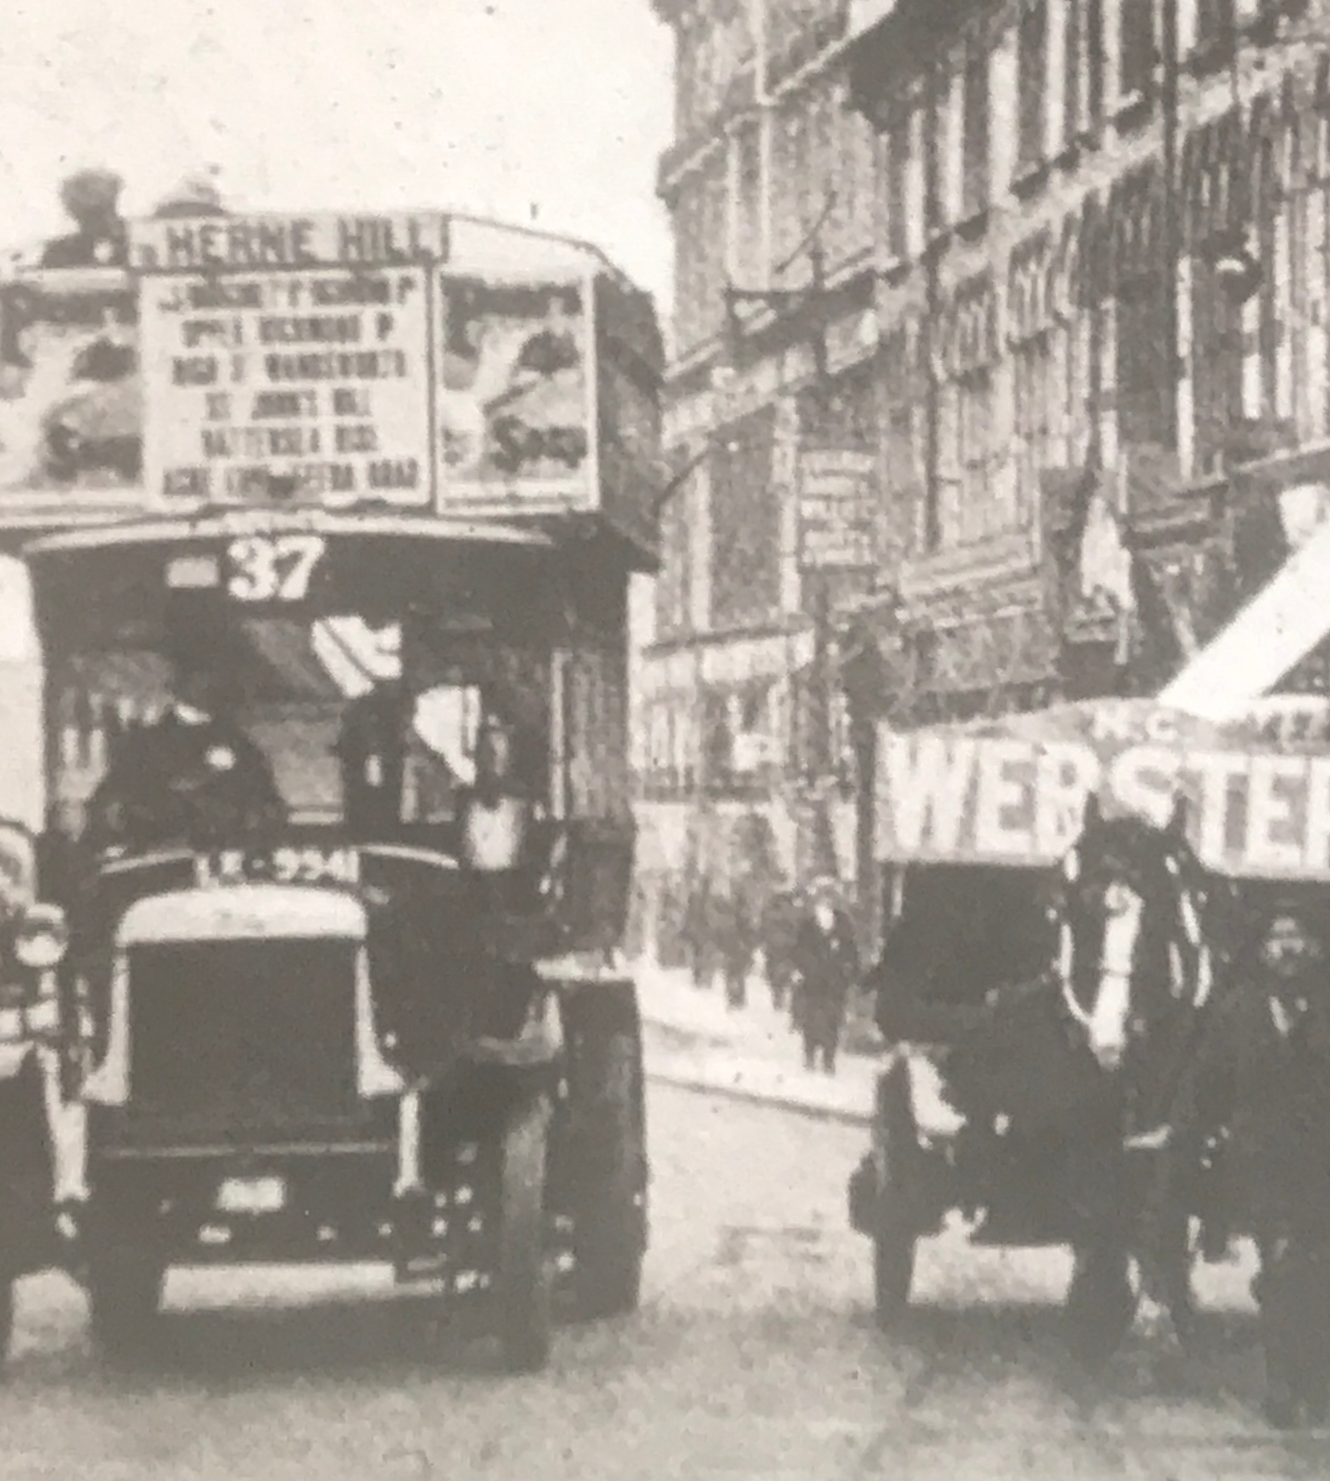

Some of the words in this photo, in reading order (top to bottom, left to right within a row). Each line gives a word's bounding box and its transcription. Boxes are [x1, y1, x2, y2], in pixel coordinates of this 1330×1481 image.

[167, 218, 316, 264] HERNE
[338, 218, 430, 263] HILL
[227, 535, 326, 601] 37
